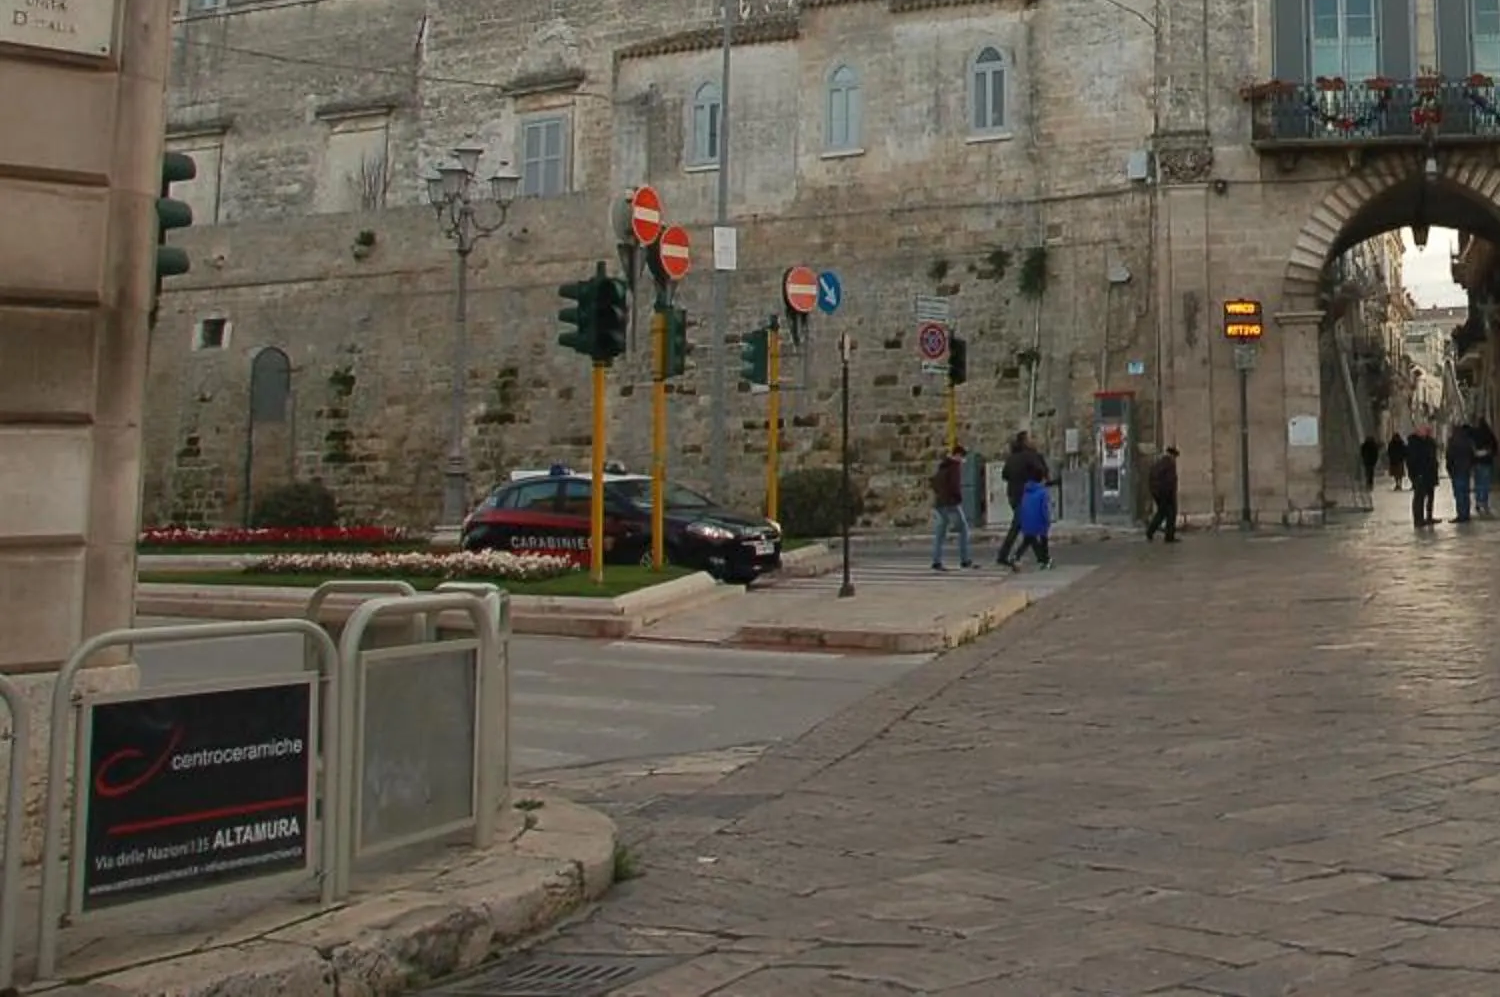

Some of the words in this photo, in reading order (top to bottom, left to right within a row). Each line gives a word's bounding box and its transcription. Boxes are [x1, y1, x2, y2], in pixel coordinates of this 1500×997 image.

[511, 535, 593, 550] CARABINIE
[173, 738, 302, 770] centroceramiche
[95, 854, 115, 872] Via
[117, 848, 146, 868] delle
[147, 840, 190, 862] Nazioni
[213, 815, 300, 848] ALTAMURA
